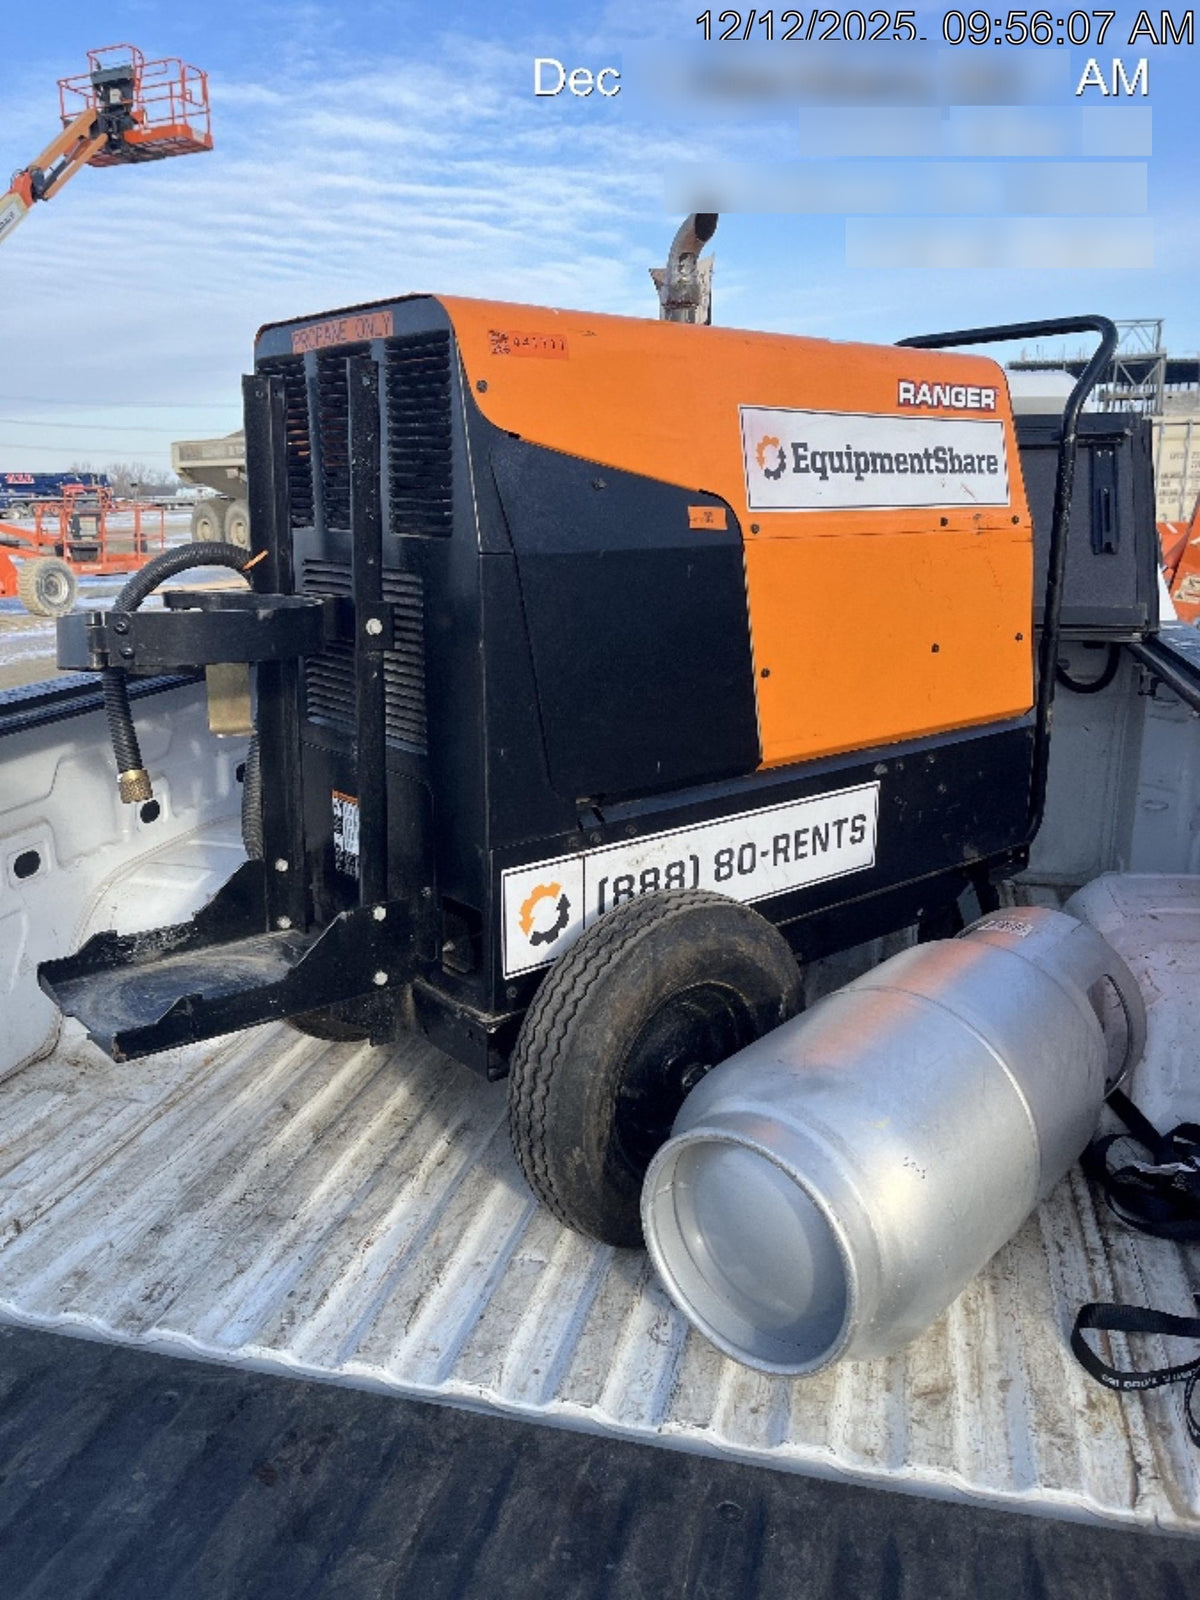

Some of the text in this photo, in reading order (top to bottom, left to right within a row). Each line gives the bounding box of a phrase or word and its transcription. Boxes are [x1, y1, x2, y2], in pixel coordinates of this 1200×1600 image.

[355, 314, 392, 339] ONLY
[897, 379, 996, 411] RANGER
[791, 442, 998, 481] EquipmentShare
[714, 813, 868, 882] 80-RENTS
